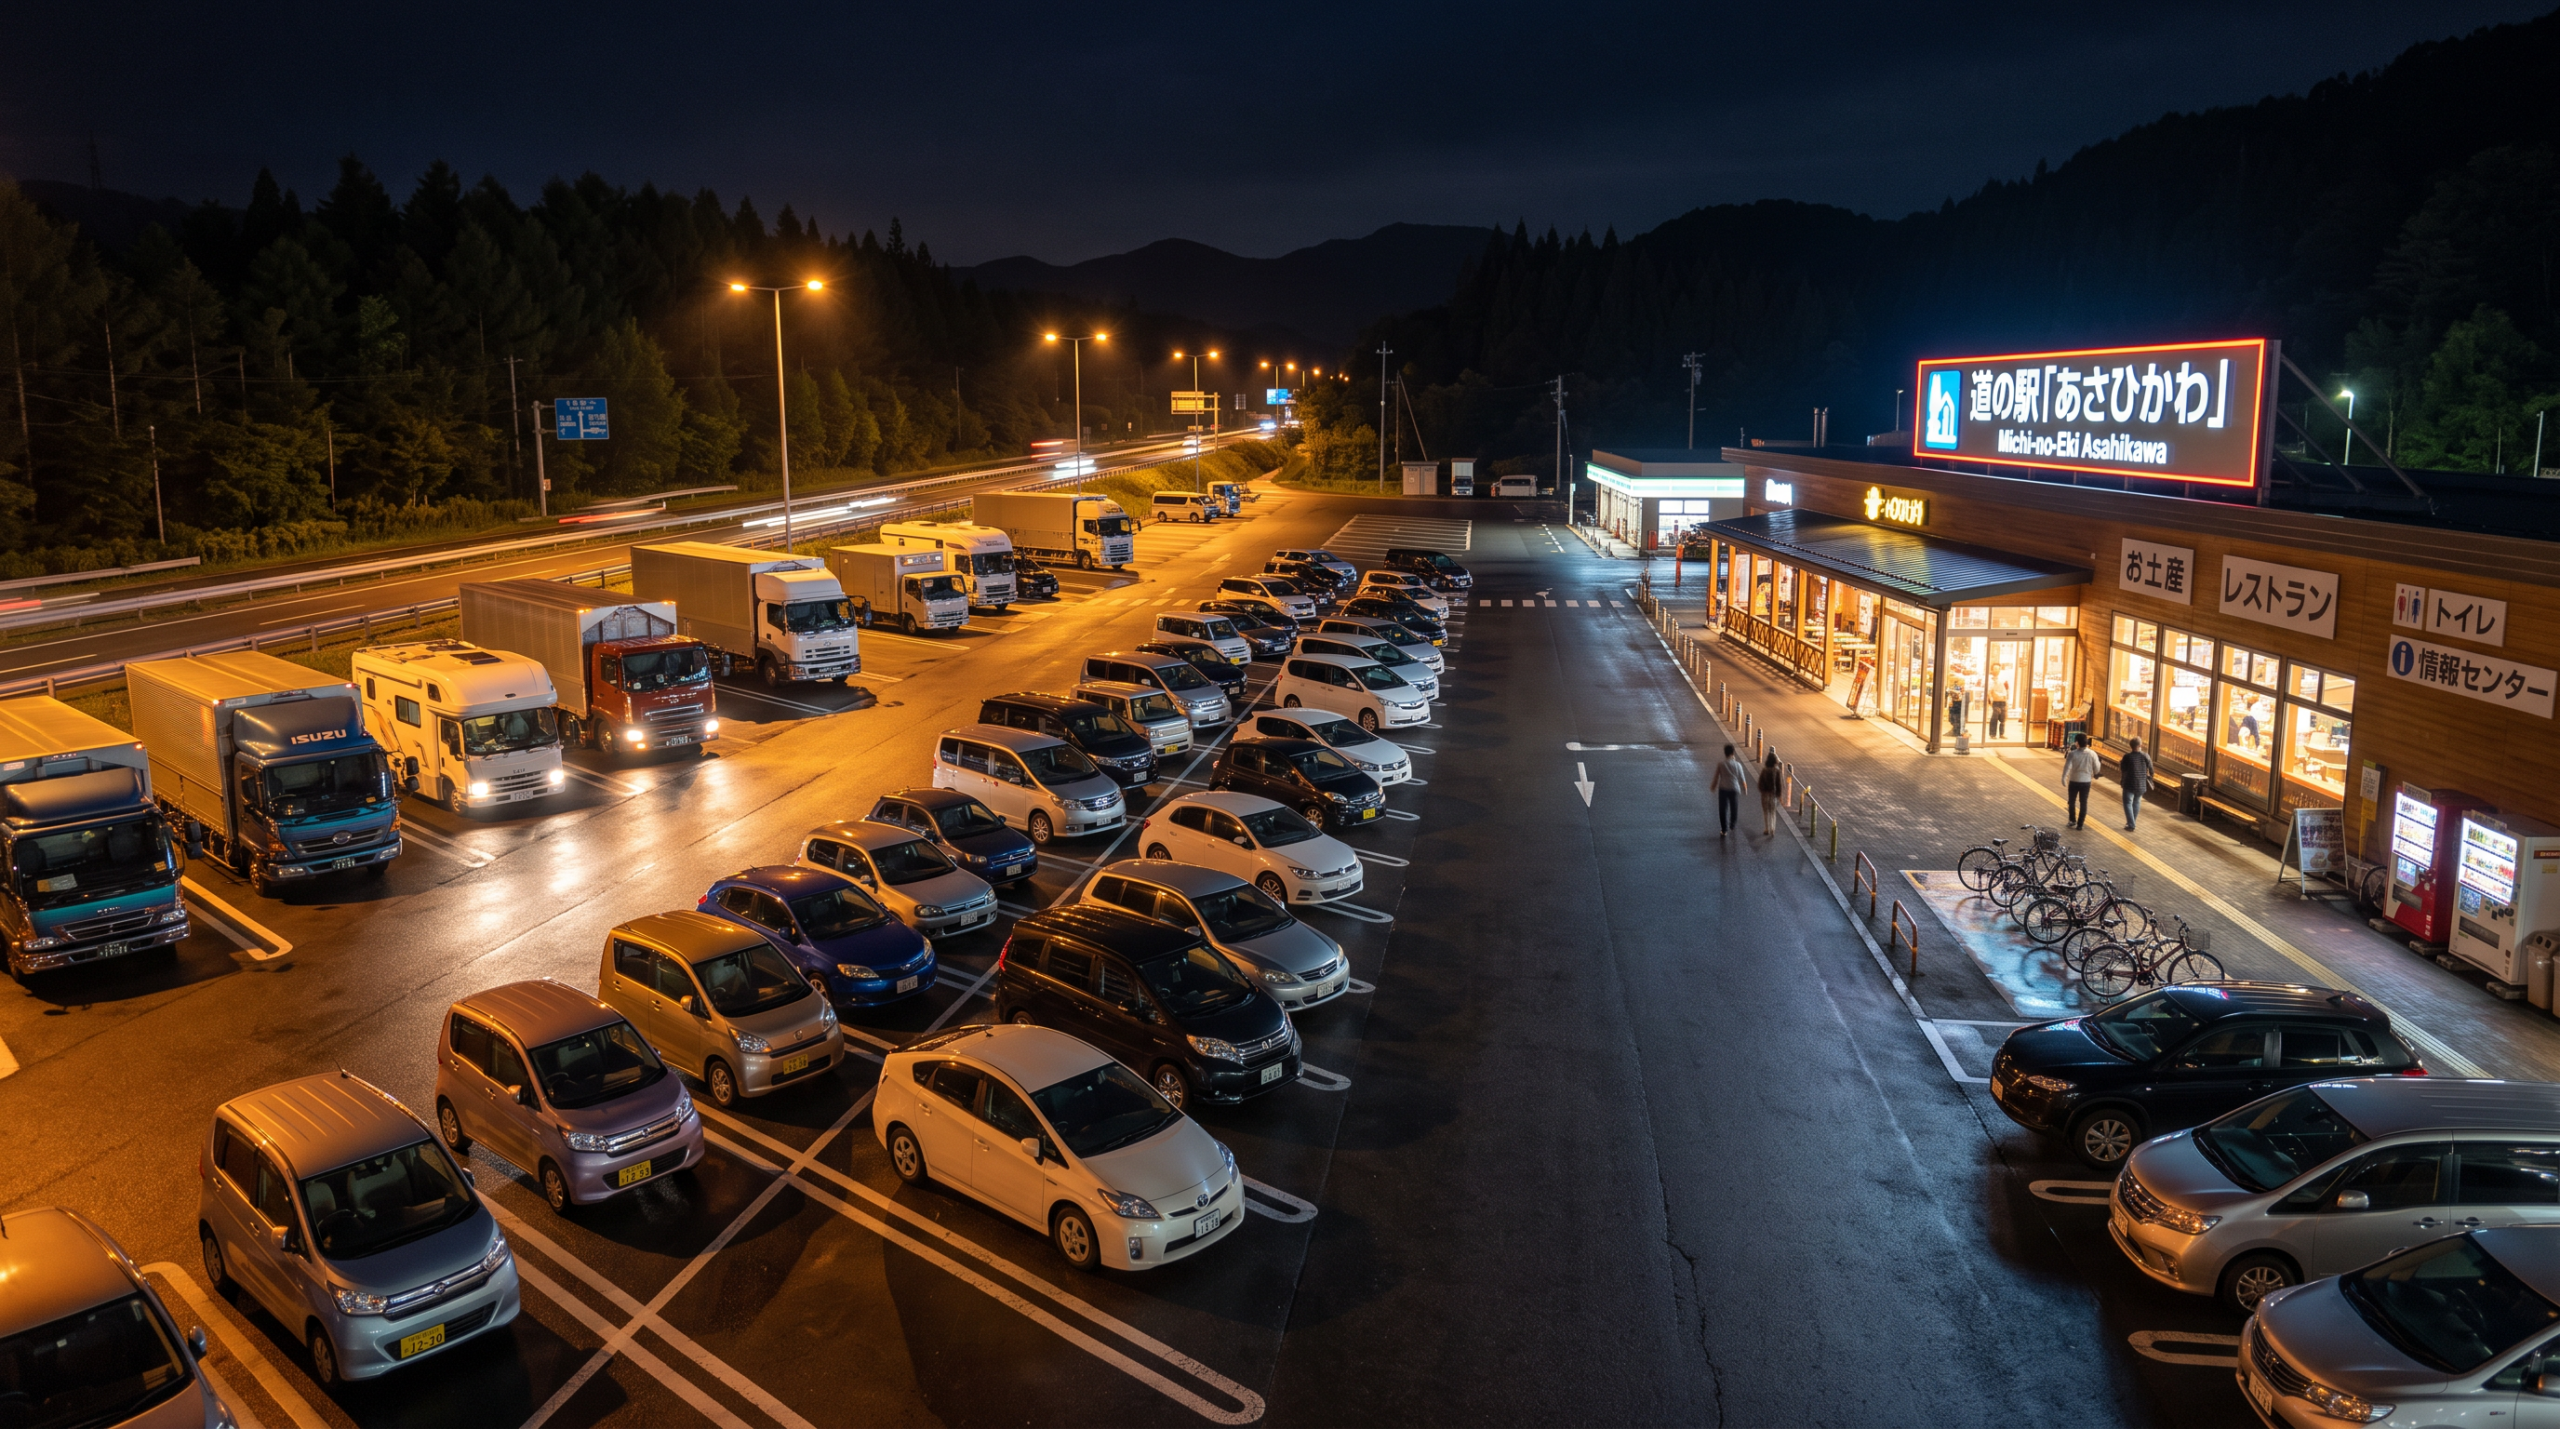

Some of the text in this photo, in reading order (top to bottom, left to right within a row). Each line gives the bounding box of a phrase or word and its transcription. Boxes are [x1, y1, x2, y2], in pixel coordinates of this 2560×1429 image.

[1970, 358, 2229, 429] 道の駅「あさひかわ」
[1998, 429, 2168, 464] Michi-no-Eki Asahikawa
[2126, 550, 2185, 595] お土産
[2224, 567, 2333, 622] レストラン
[2435, 597, 2496, 636] トイレ
[2418, 646, 2550, 700] 情報センター
[291, 729, 347, 745] ISUZU
